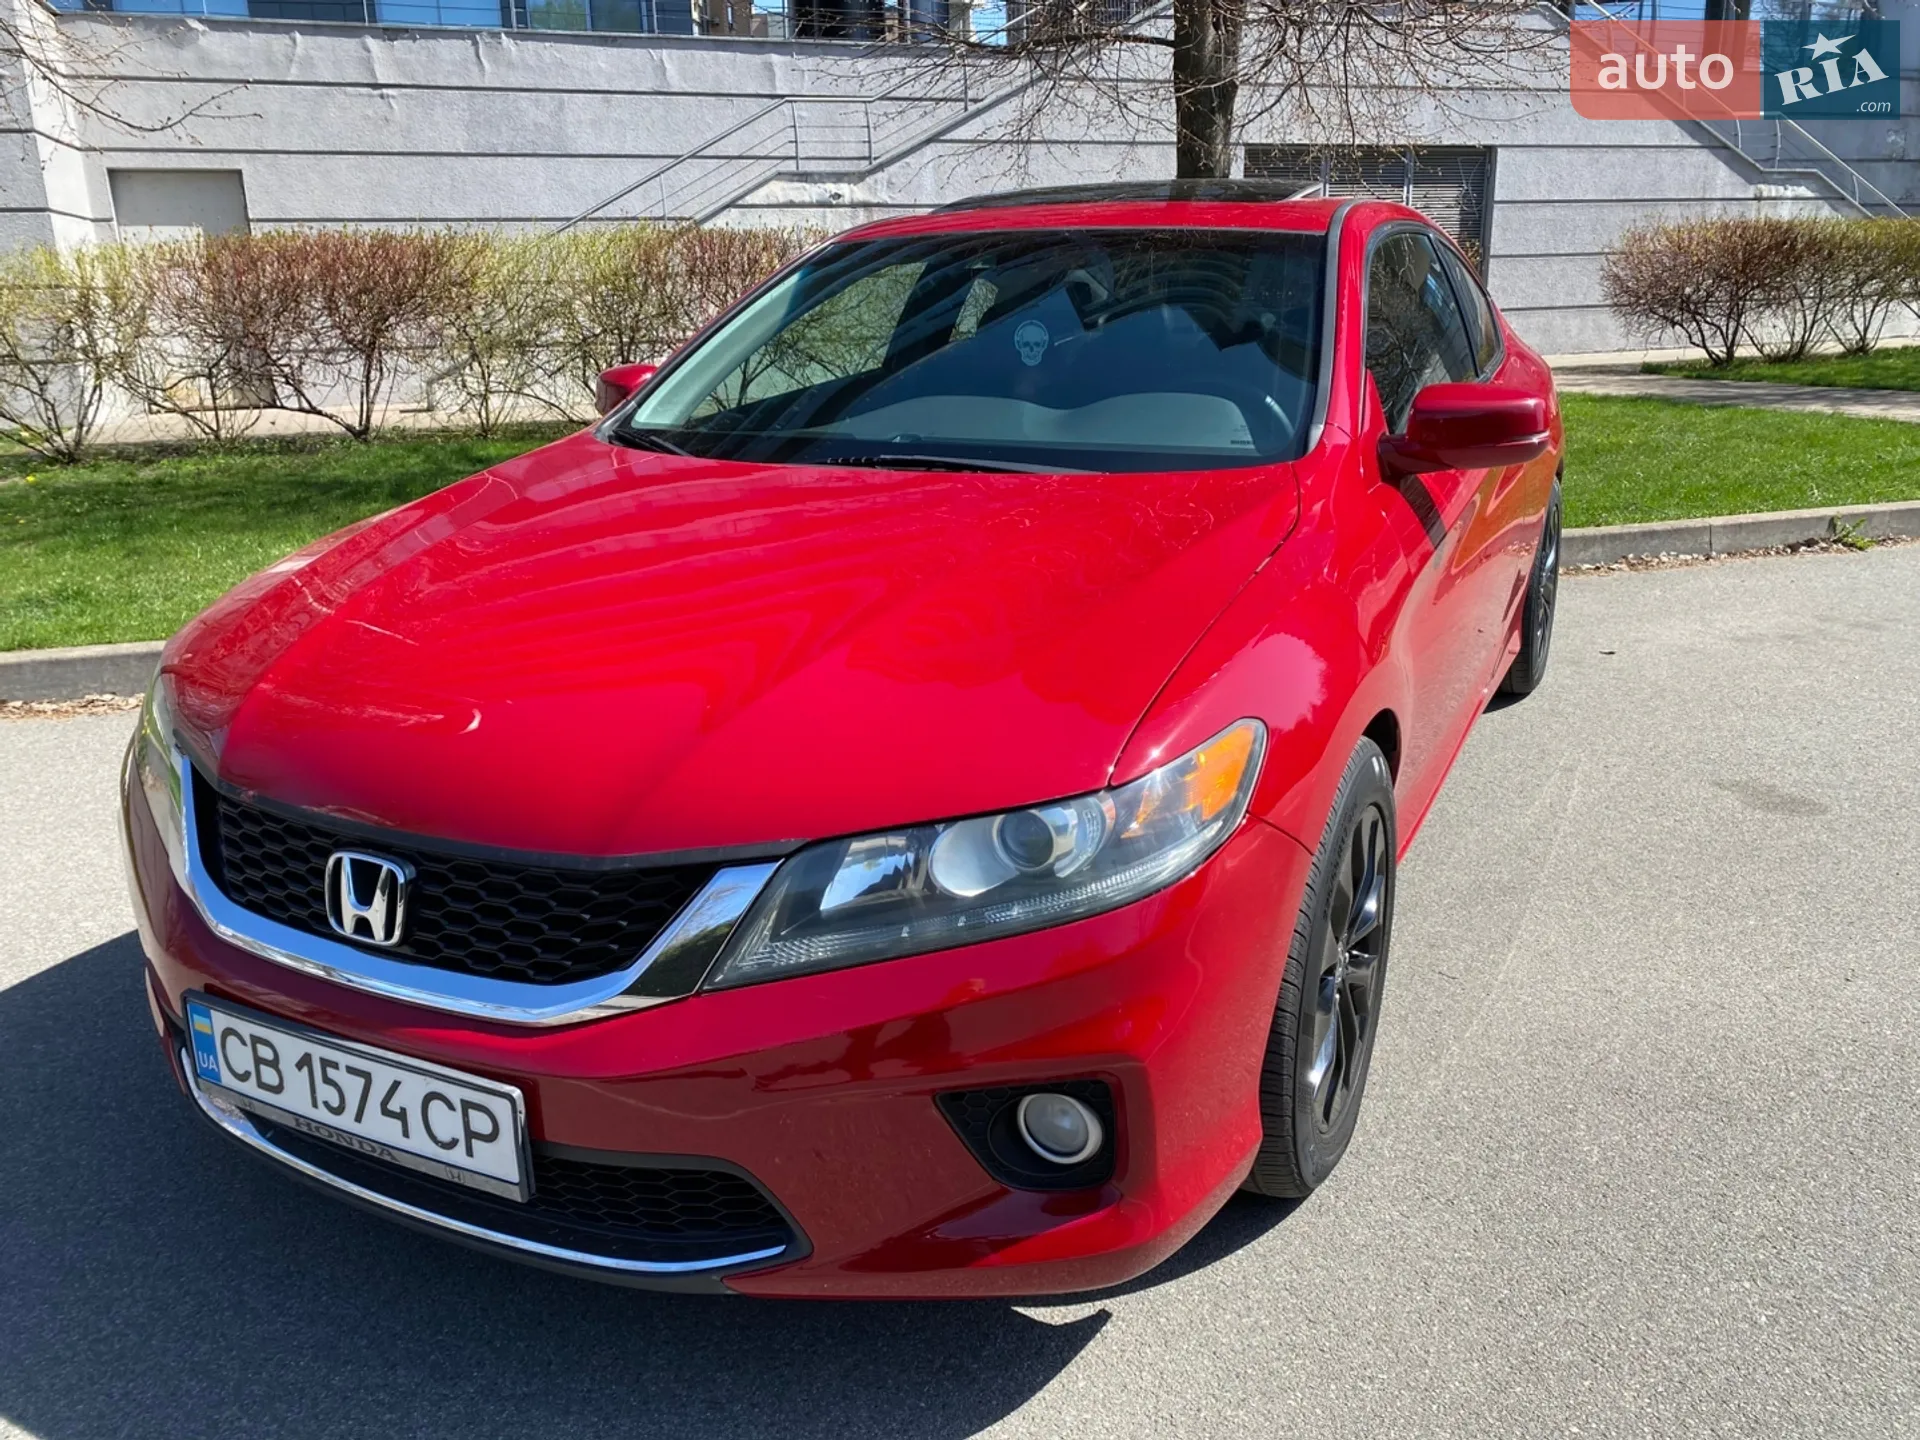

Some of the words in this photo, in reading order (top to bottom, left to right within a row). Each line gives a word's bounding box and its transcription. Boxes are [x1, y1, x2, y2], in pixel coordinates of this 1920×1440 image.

[199, 1050, 219, 1073] UA
[220, 1026, 285, 1095] CB
[295, 1052, 411, 1139] 1574
[421, 1090, 500, 1158] CP
[293, 1116, 401, 1163] HONDA
